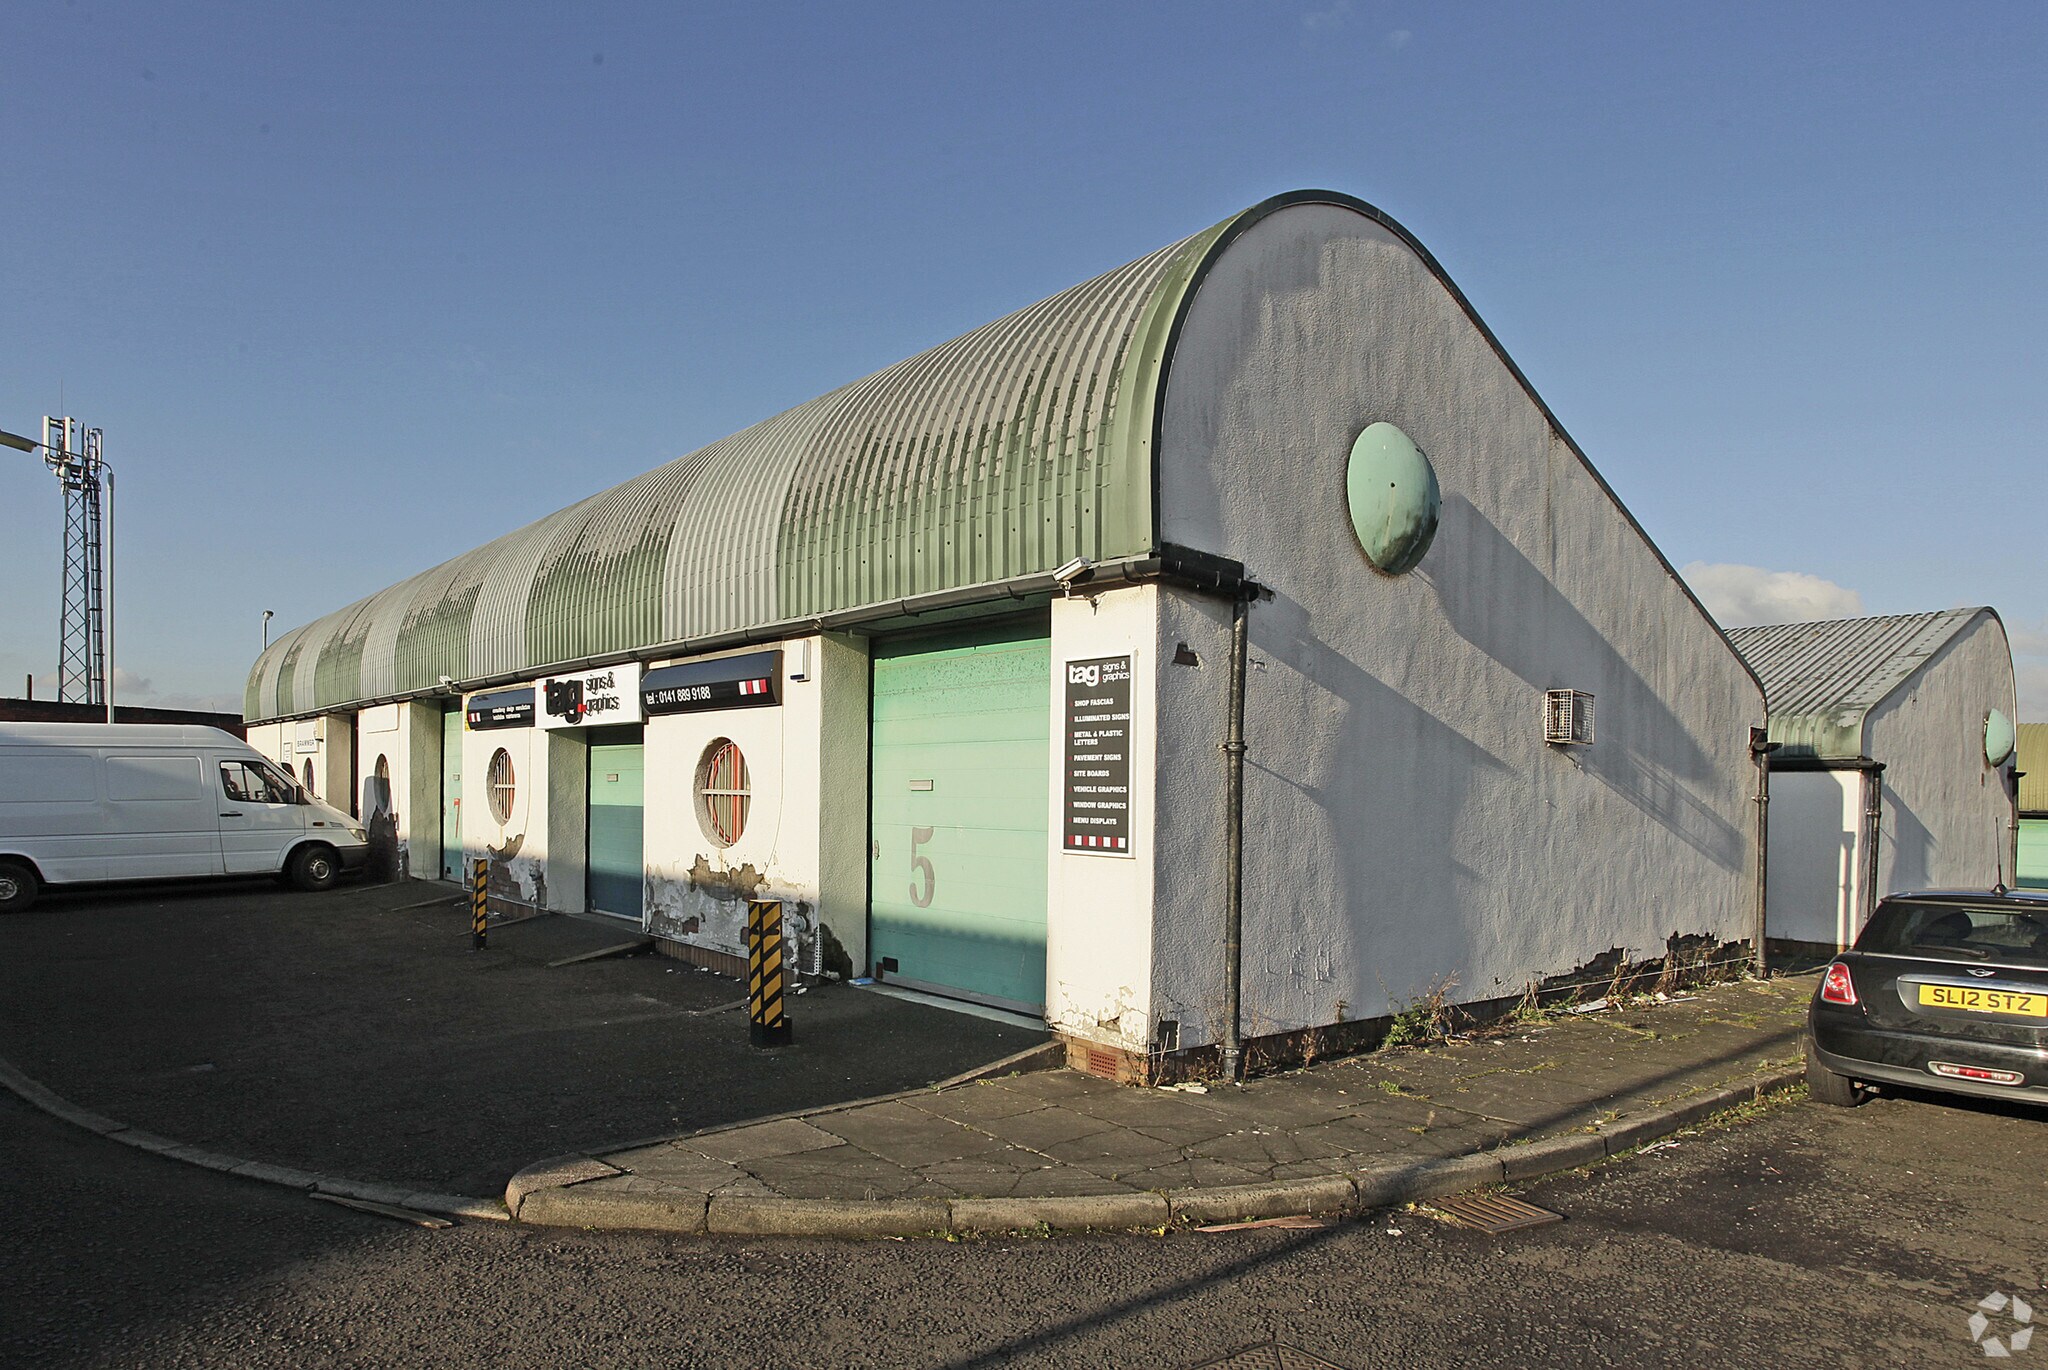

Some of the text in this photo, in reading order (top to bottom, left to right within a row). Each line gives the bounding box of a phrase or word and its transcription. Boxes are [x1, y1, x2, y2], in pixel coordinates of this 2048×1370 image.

[1069, 665, 1099, 687] tag
[1103, 661, 1126, 672] signs &
[586, 674, 606, 695] signs
[1103, 671, 1130, 683] graphics
[546, 679, 583, 724] tag
[659, 690, 676, 703] 0141
[677, 688, 690, 702] 889
[691, 686, 711, 700] 9188
[1090, 698, 1114, 706] FASCIAS
[586, 693, 620, 716] graphics
[1074, 714, 1110, 722] ILLUMINATED
[1074, 738, 1098, 746] LETTERS
[909, 826, 935, 908] 5
[1933, 988, 2031, 1011] SL12 STZ
